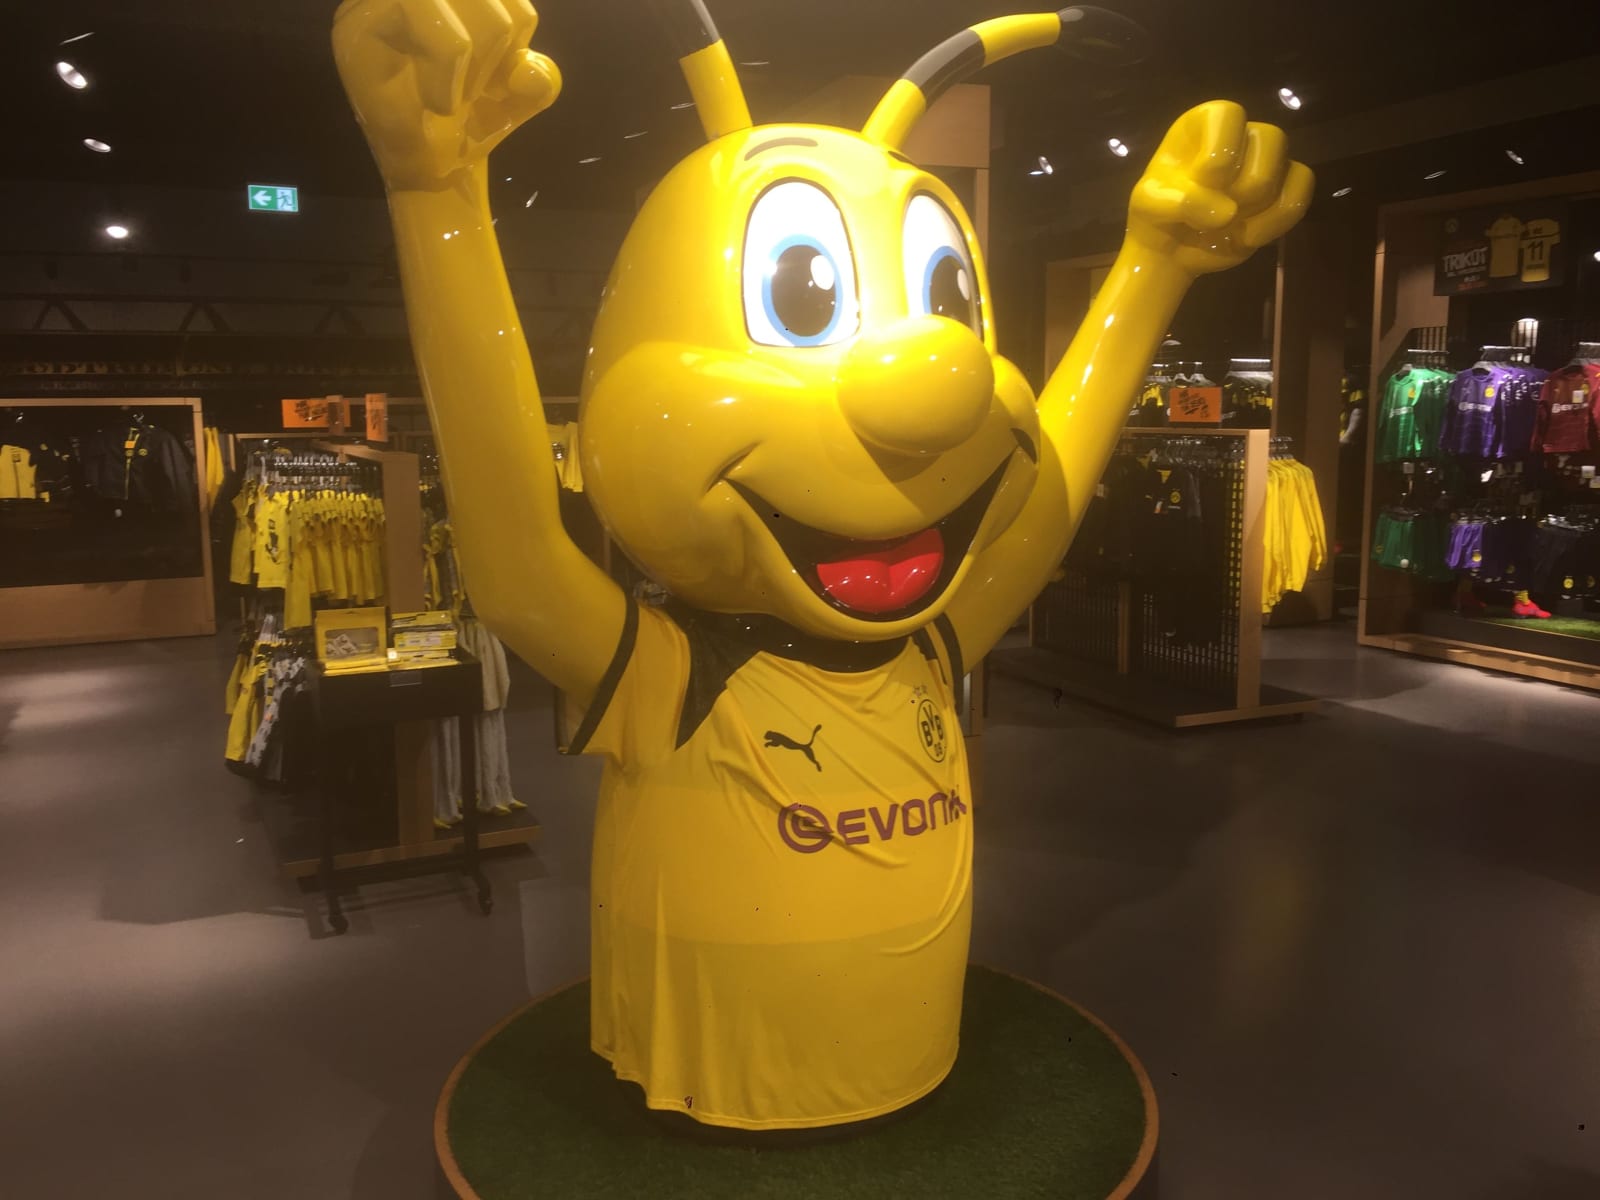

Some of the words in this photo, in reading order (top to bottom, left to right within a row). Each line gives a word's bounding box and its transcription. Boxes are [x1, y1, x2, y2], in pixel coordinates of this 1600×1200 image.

[1442, 247, 1489, 273] TRIKOT
[1527, 240, 1544, 261] 11
[921, 704, 944, 747] BVB
